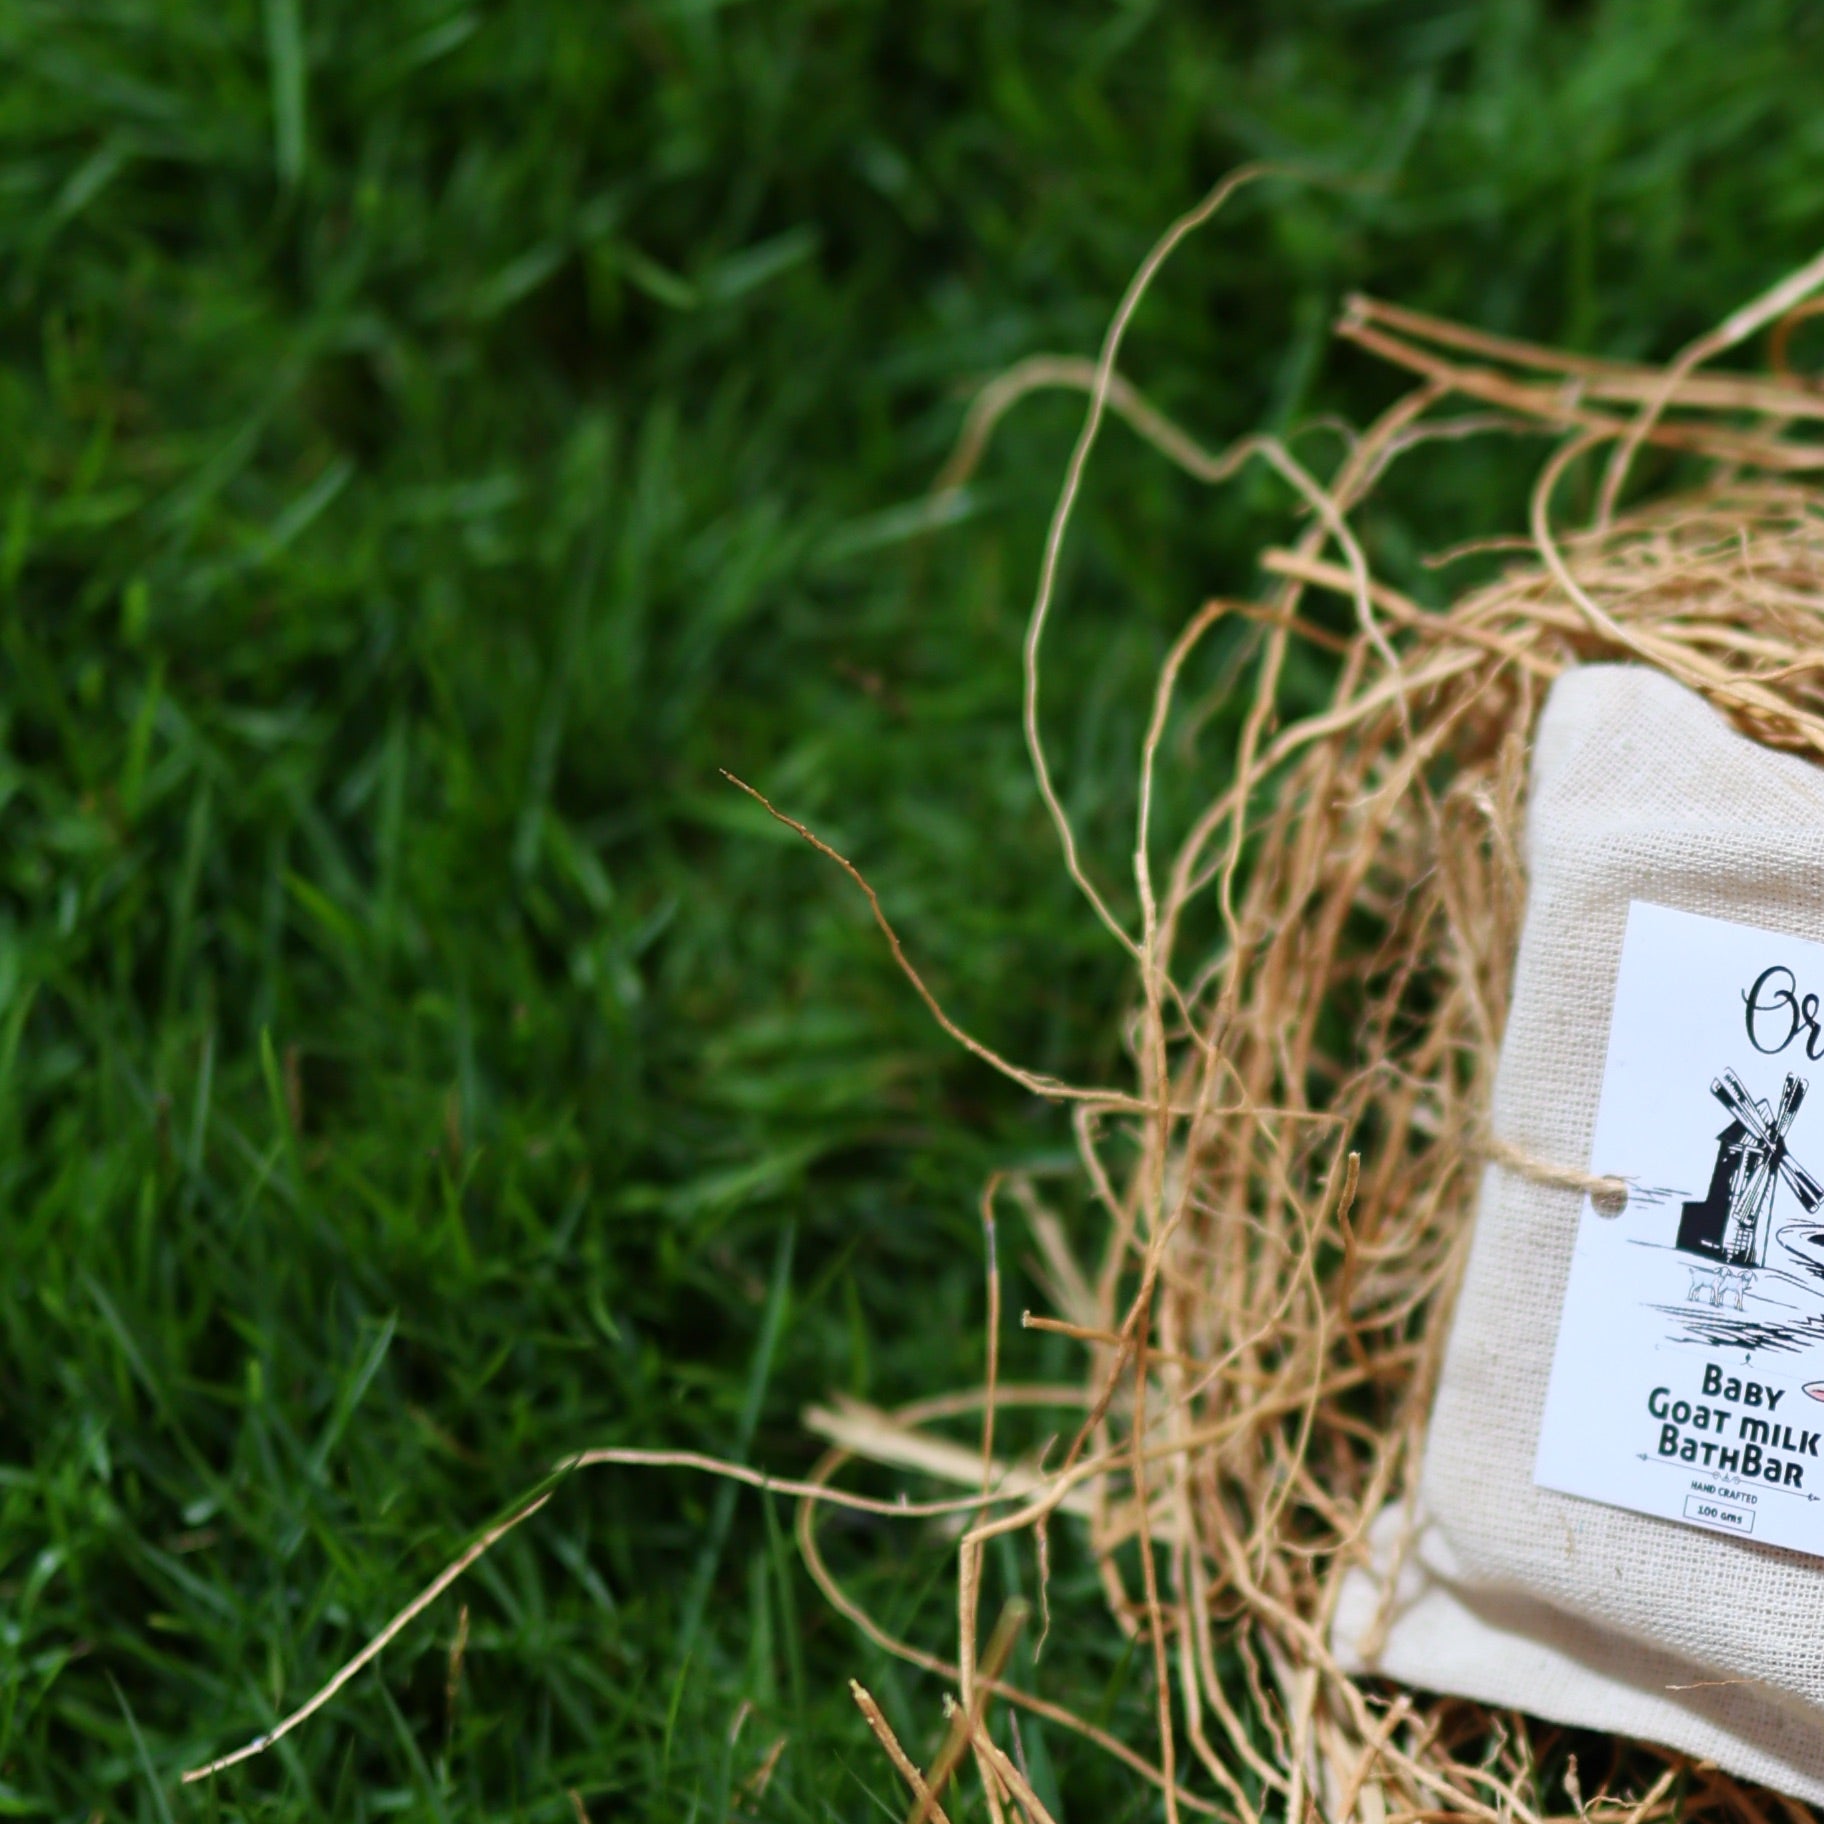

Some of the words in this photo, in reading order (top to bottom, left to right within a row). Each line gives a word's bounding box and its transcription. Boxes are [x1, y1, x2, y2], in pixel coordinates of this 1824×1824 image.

[1691, 1480, 1716, 1495] HAND
[1718, 1487, 1758, 1505] CRAFTED
[1698, 1505, 1718, 1518] 100
